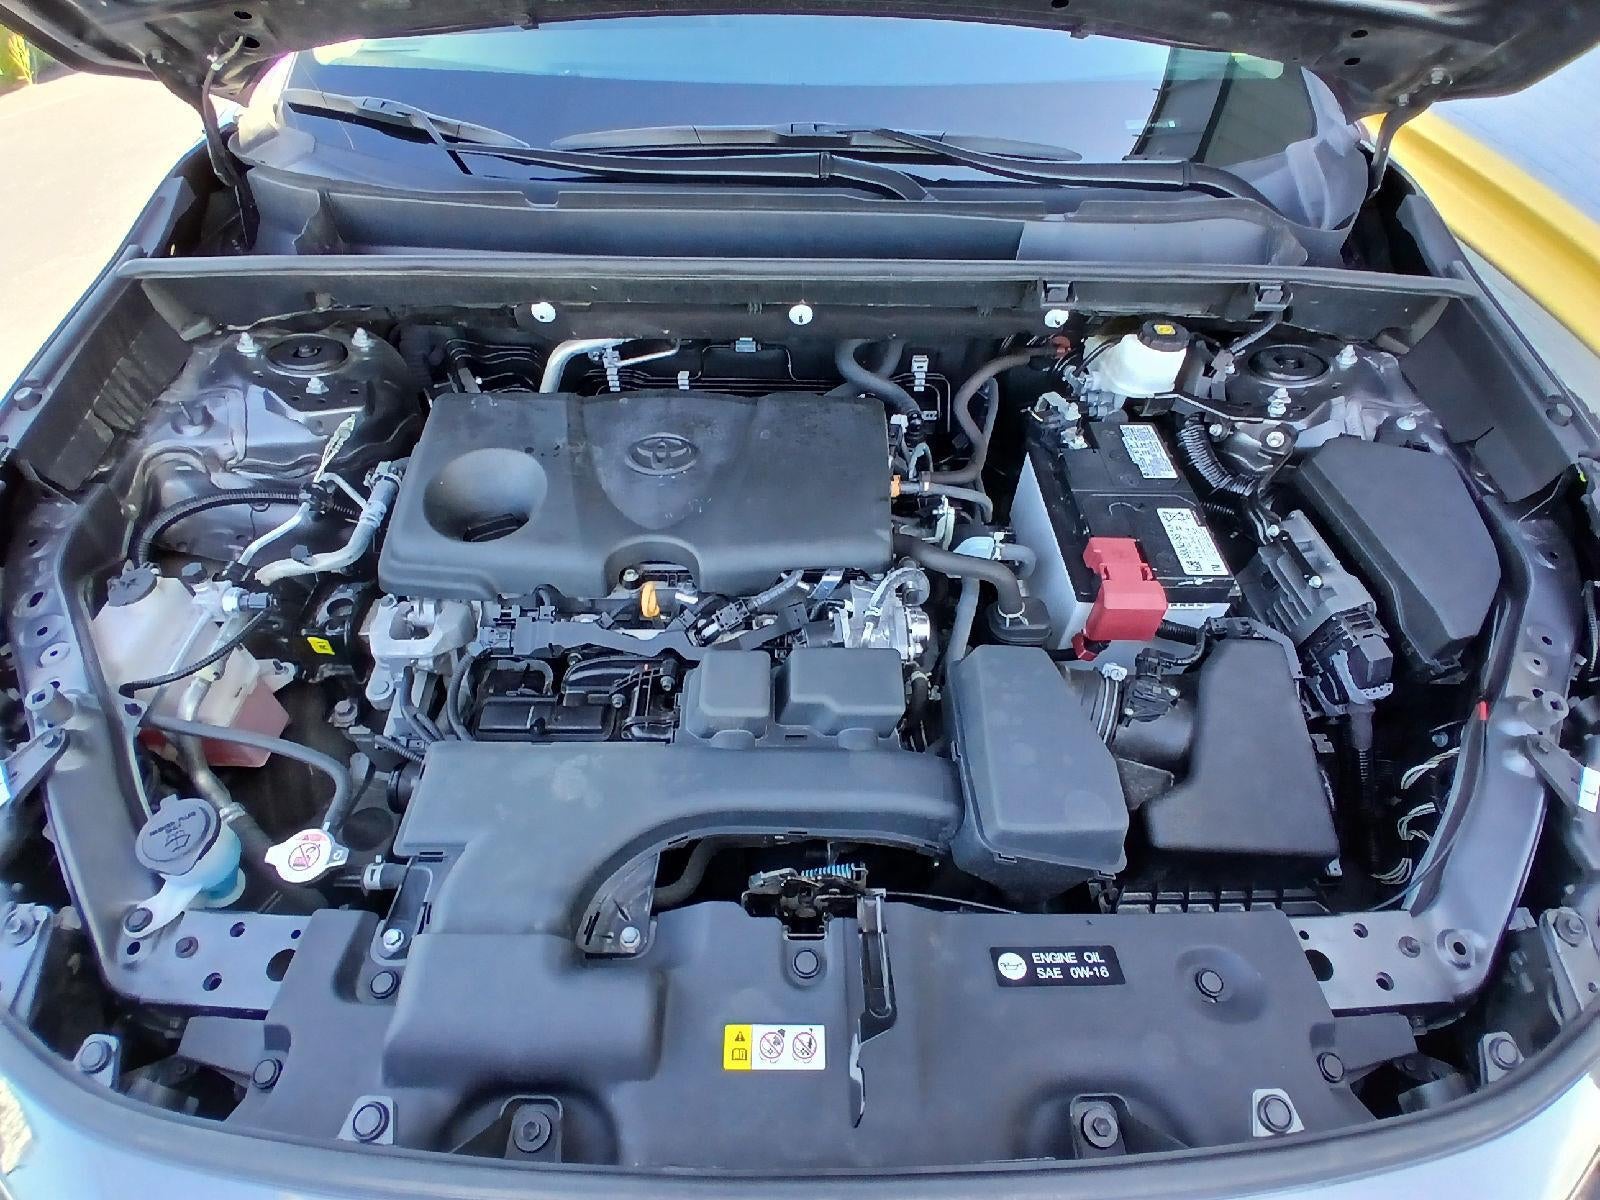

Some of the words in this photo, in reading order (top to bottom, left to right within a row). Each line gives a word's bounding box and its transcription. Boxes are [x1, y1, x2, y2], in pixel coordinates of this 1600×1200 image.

[1031, 952, 1078, 964] ENGINE
[1083, 952, 1106, 963] OIL
[1036, 967, 1064, 979] SAE
